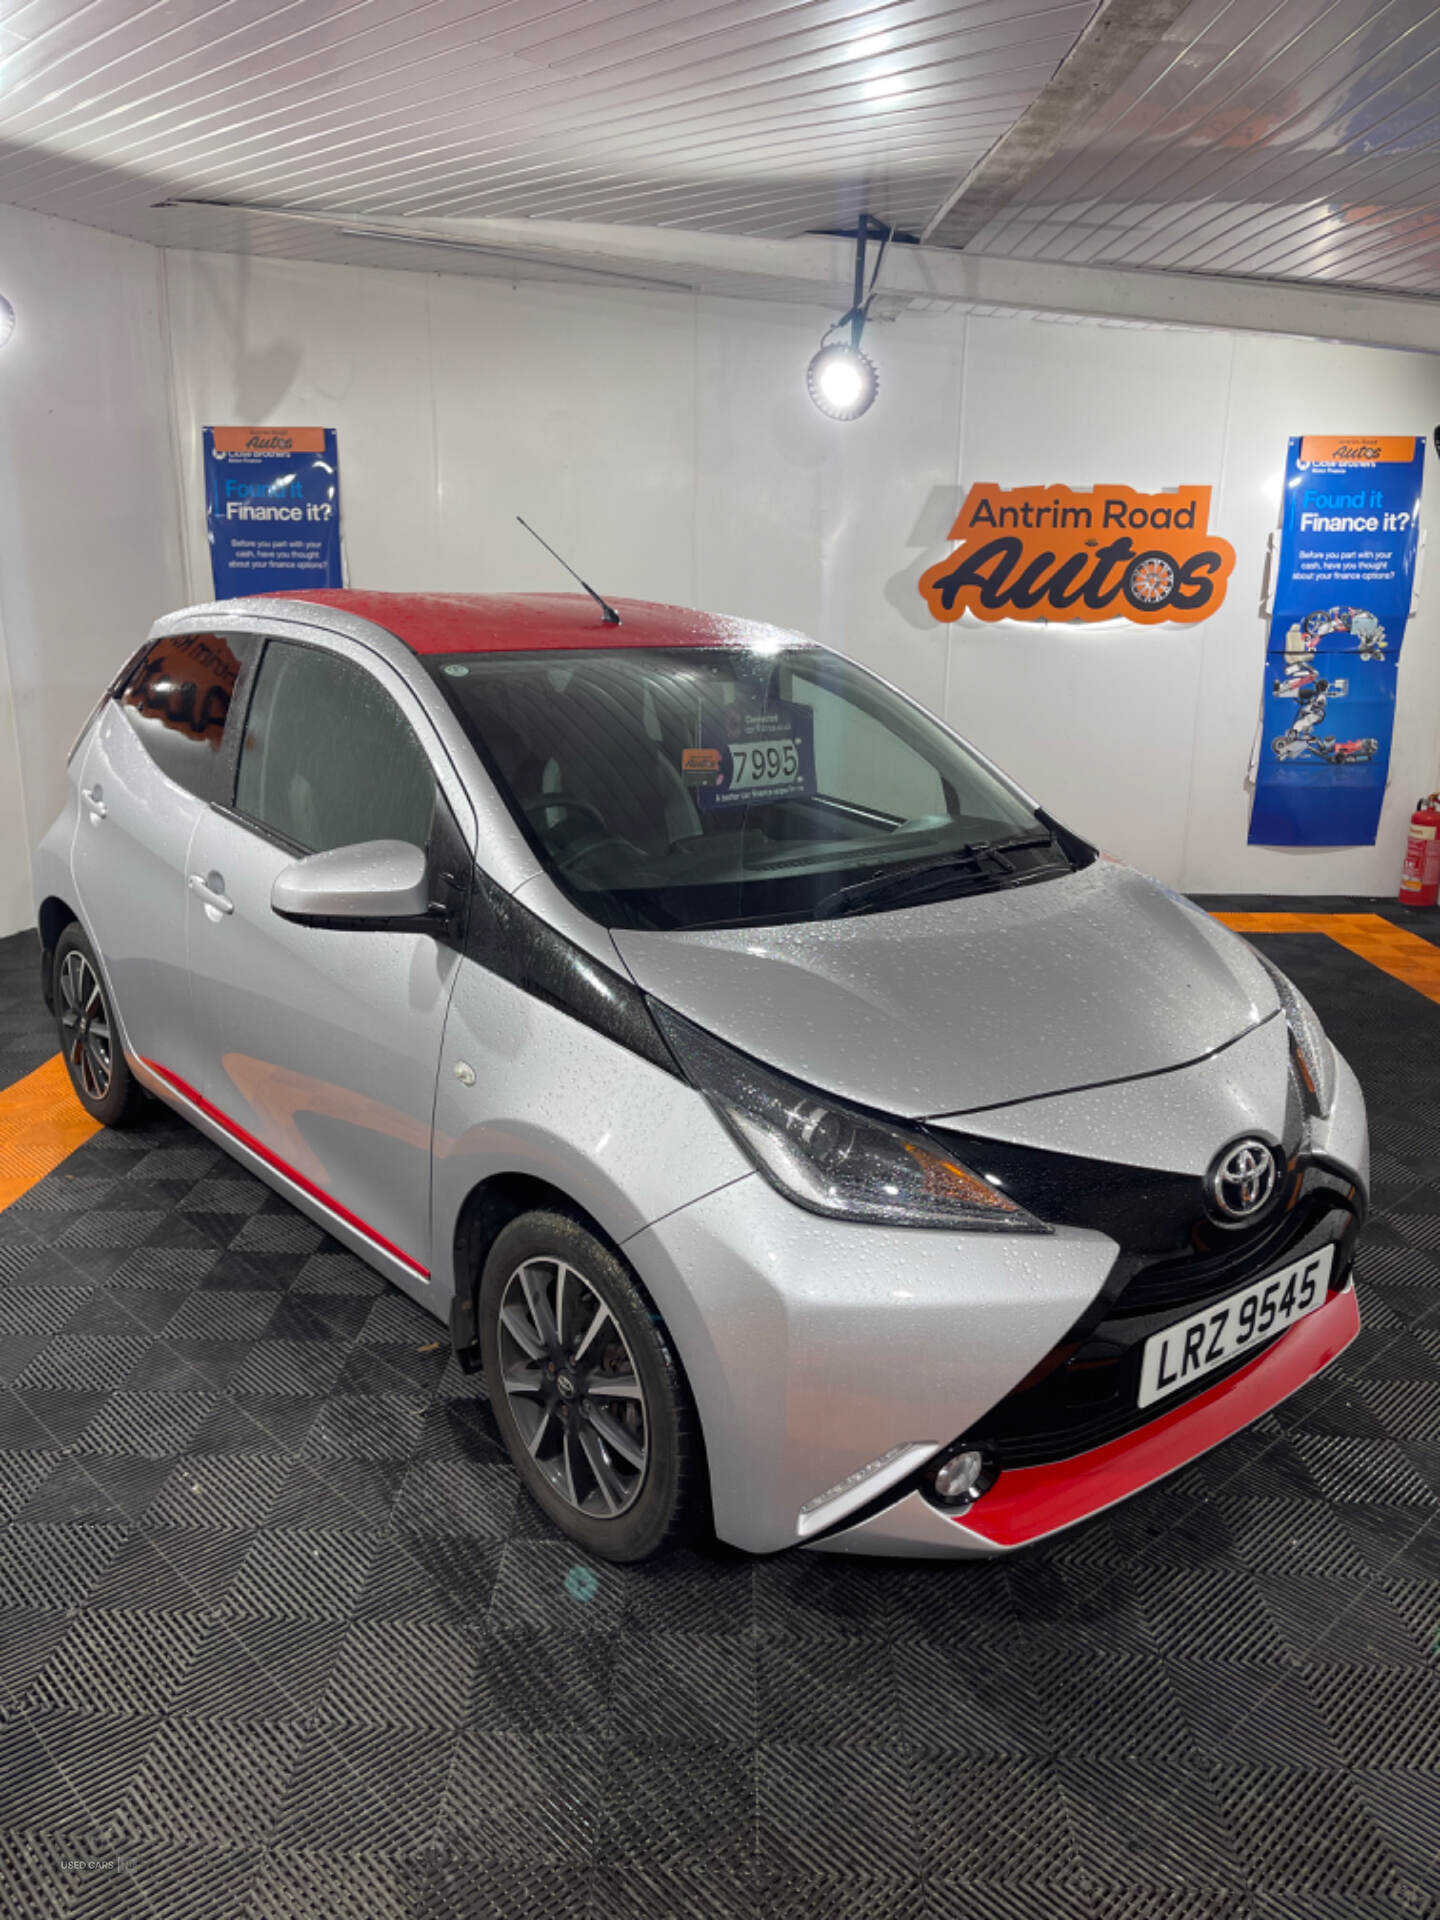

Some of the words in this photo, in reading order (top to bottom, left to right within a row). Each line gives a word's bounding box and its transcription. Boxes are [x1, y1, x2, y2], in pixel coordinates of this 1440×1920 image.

[245, 436, 292, 449] Autos
[1332, 446, 1382, 459] Autos
[225, 479, 286, 498] Found
[290, 480, 304, 498] it
[1303, 490, 1366, 509] Found
[1369, 490, 1384, 509] it
[226, 501, 302, 521] Finance
[306, 502, 332, 521] it?
[969, 498, 1092, 528] Antrim
[1102, 499, 1196, 529] Road
[1301, 512, 1379, 532] Finance
[1383, 512, 1410, 531] it?
[231, 539, 256, 547] Before
[257, 541, 271, 549] you
[272, 540, 287, 549] part
[289, 540, 304, 548] with
[305, 541, 322, 550] your
[257, 550, 275, 558] have
[276, 551, 290, 559] you
[291, 550, 320, 560] thought
[1299, 550, 1324, 559] Before
[1325, 552, 1339, 561] you
[1340, 551, 1356, 561] part
[1358, 550, 1374, 559] with
[1374, 552, 1393, 561] your
[228, 560, 250, 568] about
[251, 561, 267, 569] your
[268, 560, 295, 568] finance
[1323, 561, 1341, 570] have
[1342, 562, 1357, 571] you
[1358, 561, 1388, 571] thought
[932, 536, 1222, 612] Autos
[1292, 572, 1314, 580] about
[1315, 573, 1332, 581] your
[1333, 571, 1361, 580] finance
[1361, 571, 1396, 581] options?
[733, 746, 797, 783] 7995
[1157, 1308, 1230, 1390] LRZ
[1236, 1260, 1320, 1345] 9545
